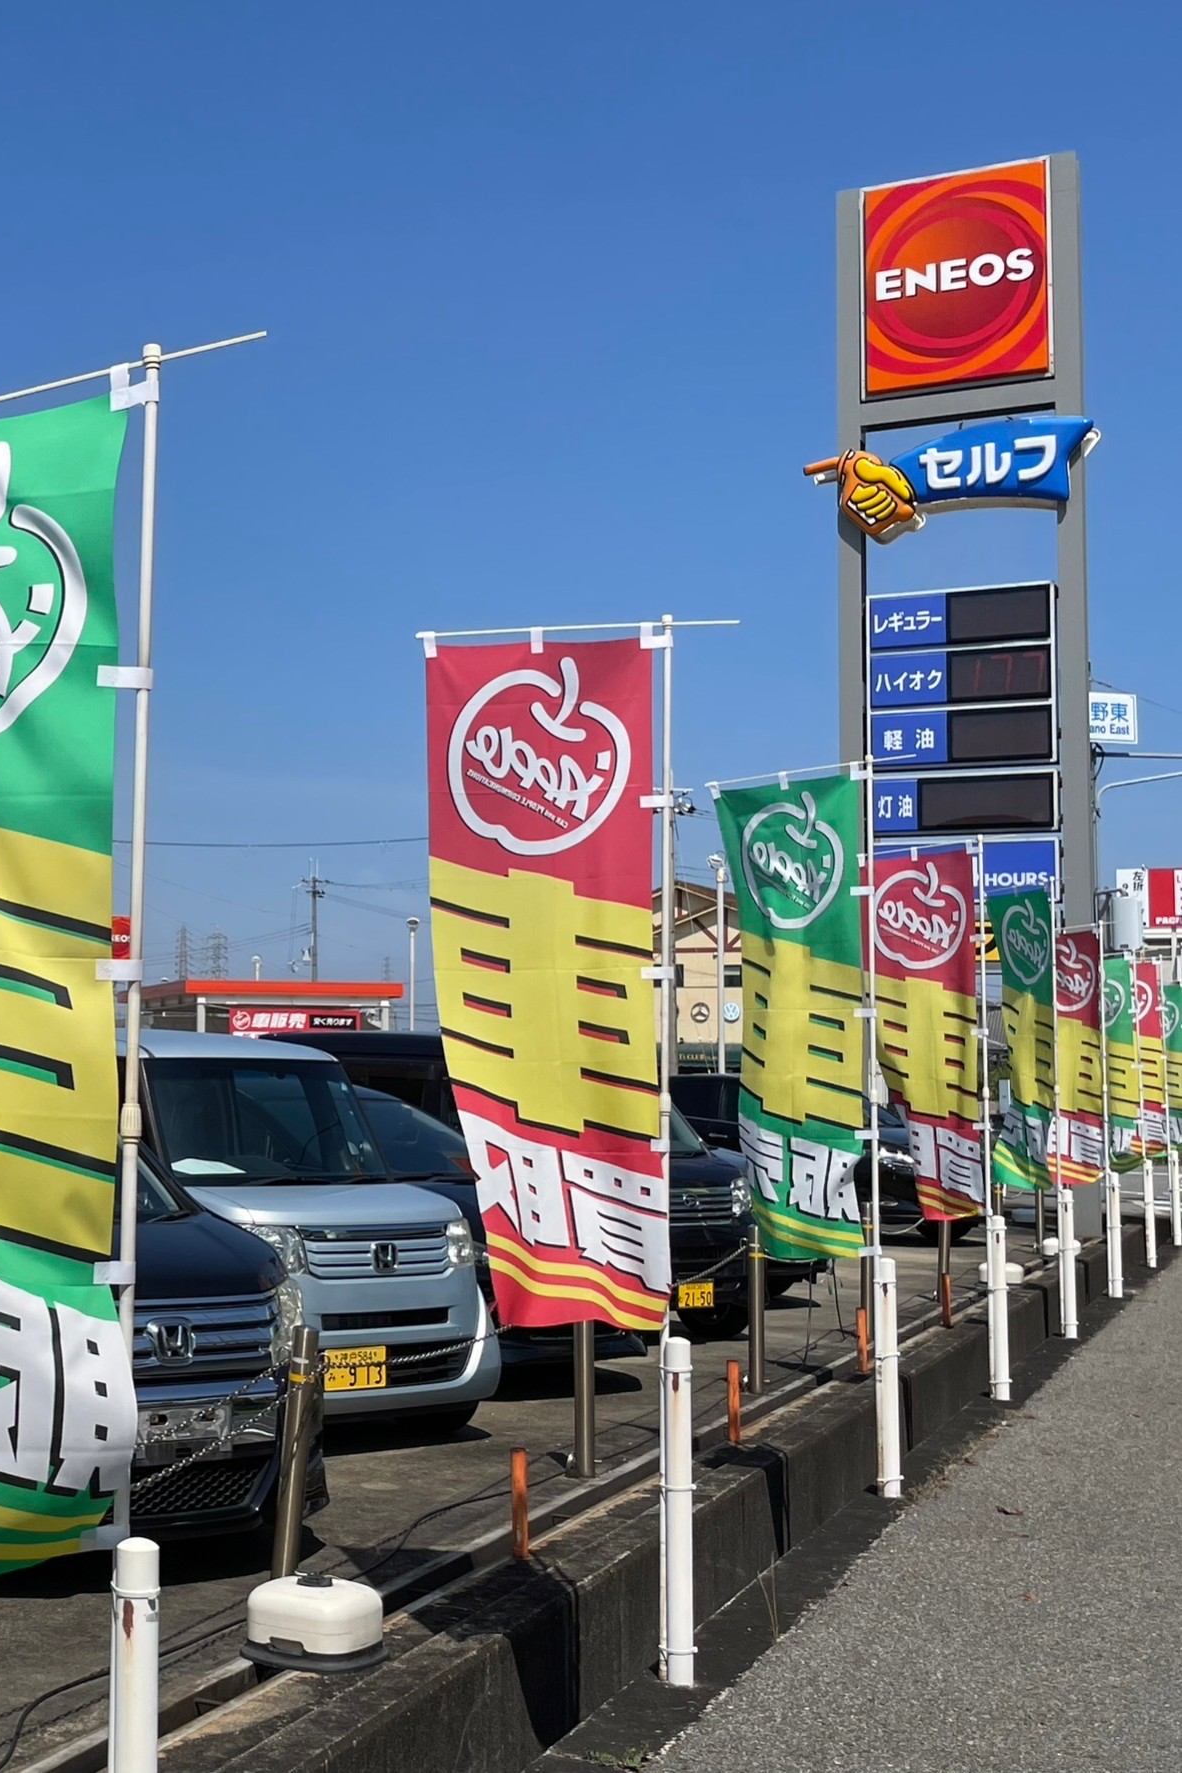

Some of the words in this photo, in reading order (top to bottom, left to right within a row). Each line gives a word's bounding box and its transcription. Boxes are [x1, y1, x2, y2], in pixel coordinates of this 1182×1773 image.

[875, 247, 1035, 302] ENEOS
[919, 434, 1058, 490] セルフ
[873, 610, 943, 634] レギュラー
[875, 669, 943, 693] ハイオク
[1091, 702, 1129, 722] 野東
[883, 728, 935, 751] 軽油
[1110, 724, 1129, 735] East
[878, 795, 913, 819] 灯油
[984, 872, 1048, 887] HOURS
[251, 1013, 307, 1029] 車販売
[685, 1291, 712, 1307] 21-50
